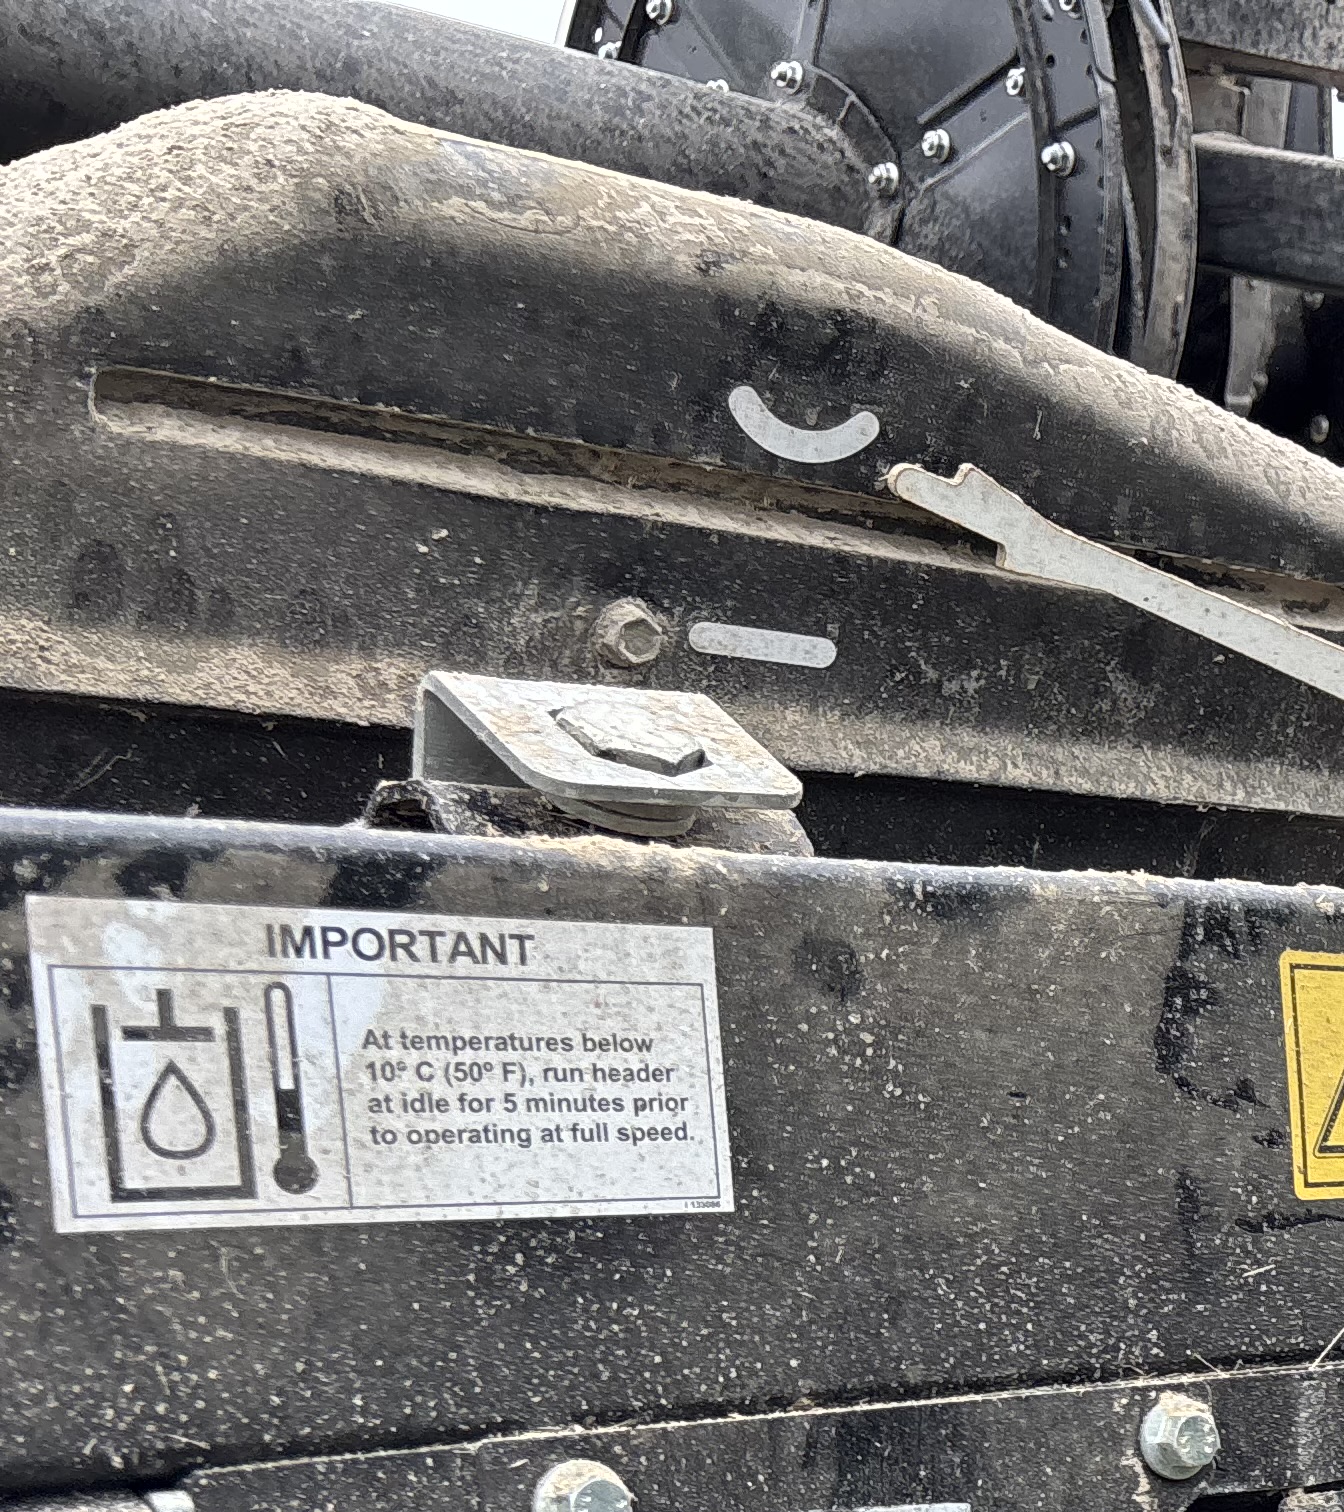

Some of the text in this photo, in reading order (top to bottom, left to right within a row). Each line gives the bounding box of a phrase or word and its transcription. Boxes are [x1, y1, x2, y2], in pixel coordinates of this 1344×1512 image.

[267, 923, 536, 968] IMPORTANT
[362, 1029, 653, 1056] At temperatures below
[415, 1061, 435, 1082] C
[503, 1062, 535, 1087] F),
[543, 1066, 584, 1083] run
[592, 1063, 674, 1083] header
[368, 1092, 689, 1117] at idle for 5 minutes prior
[370, 1121, 695, 1148] to operating at full speed.
